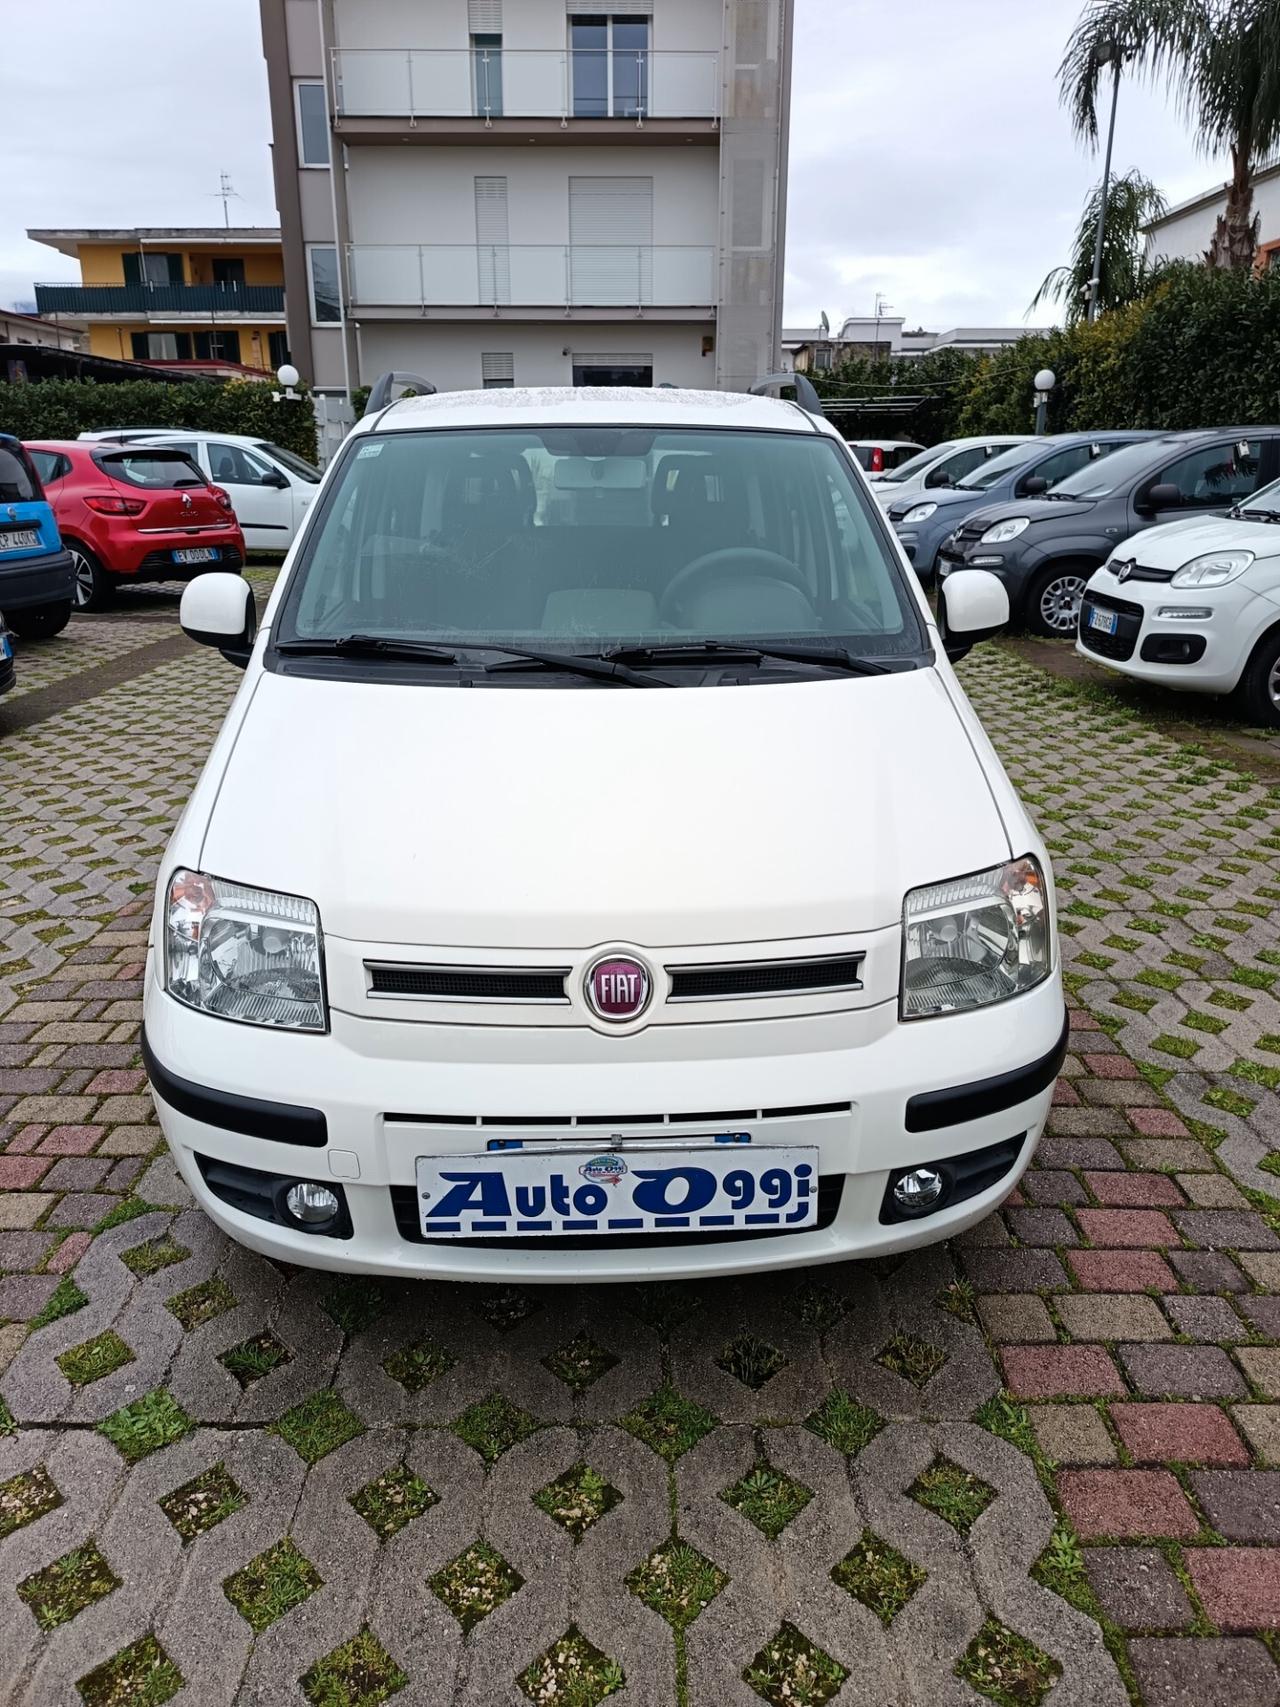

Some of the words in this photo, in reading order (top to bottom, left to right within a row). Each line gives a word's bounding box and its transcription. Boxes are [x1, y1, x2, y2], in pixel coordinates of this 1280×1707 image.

[601, 974, 637, 1003] FIAT
[425, 1171, 608, 1217] Auto
[632, 1163, 813, 1222] Oggi
